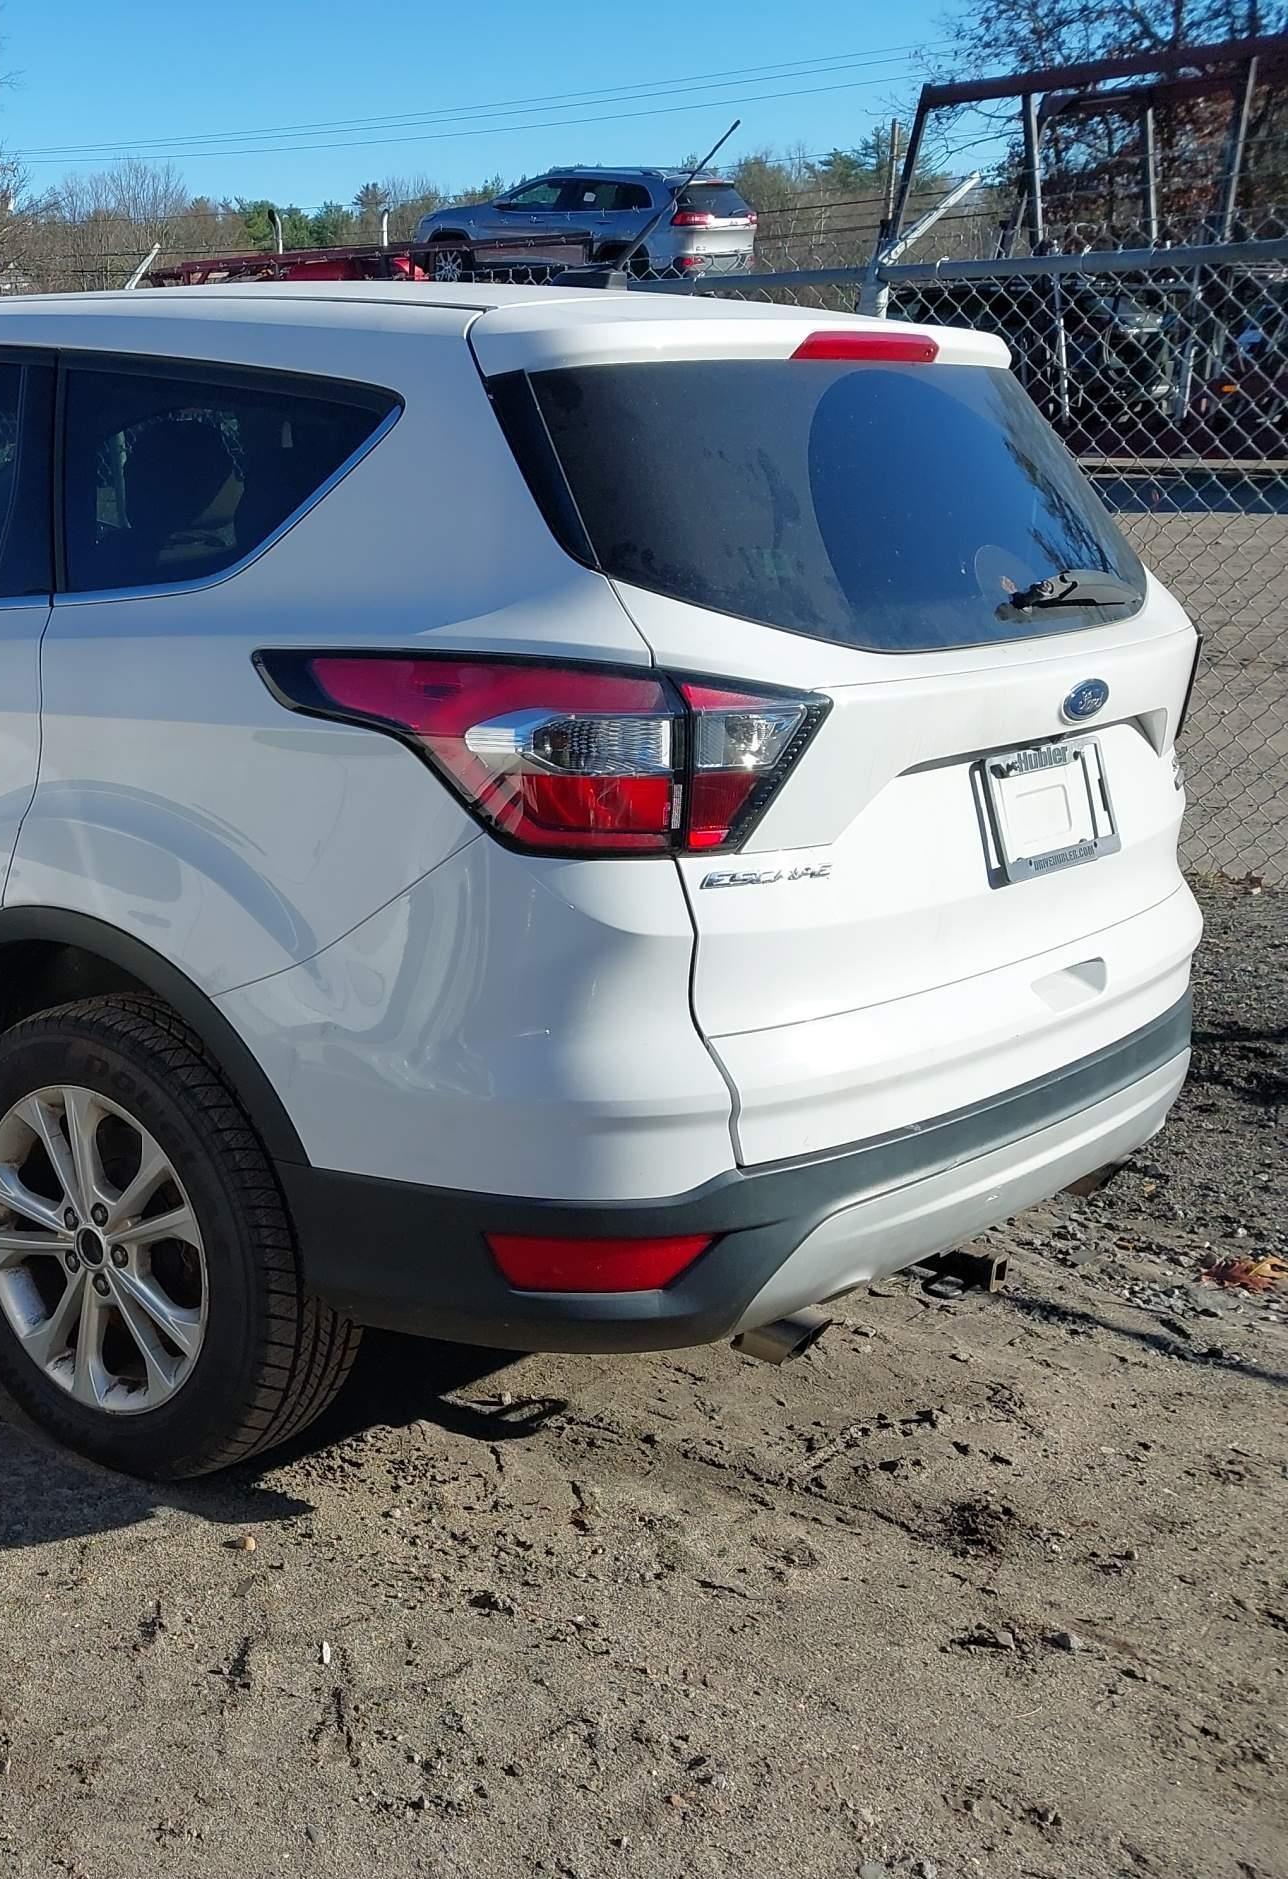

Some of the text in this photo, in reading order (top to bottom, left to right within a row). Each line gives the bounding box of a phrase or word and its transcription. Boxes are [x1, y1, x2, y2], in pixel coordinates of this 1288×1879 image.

[1017, 746, 1068, 772] Hubler
[1033, 845, 1095, 871] DRIVEHUBLER.COM
[700, 863, 832, 889] ESCAPE
